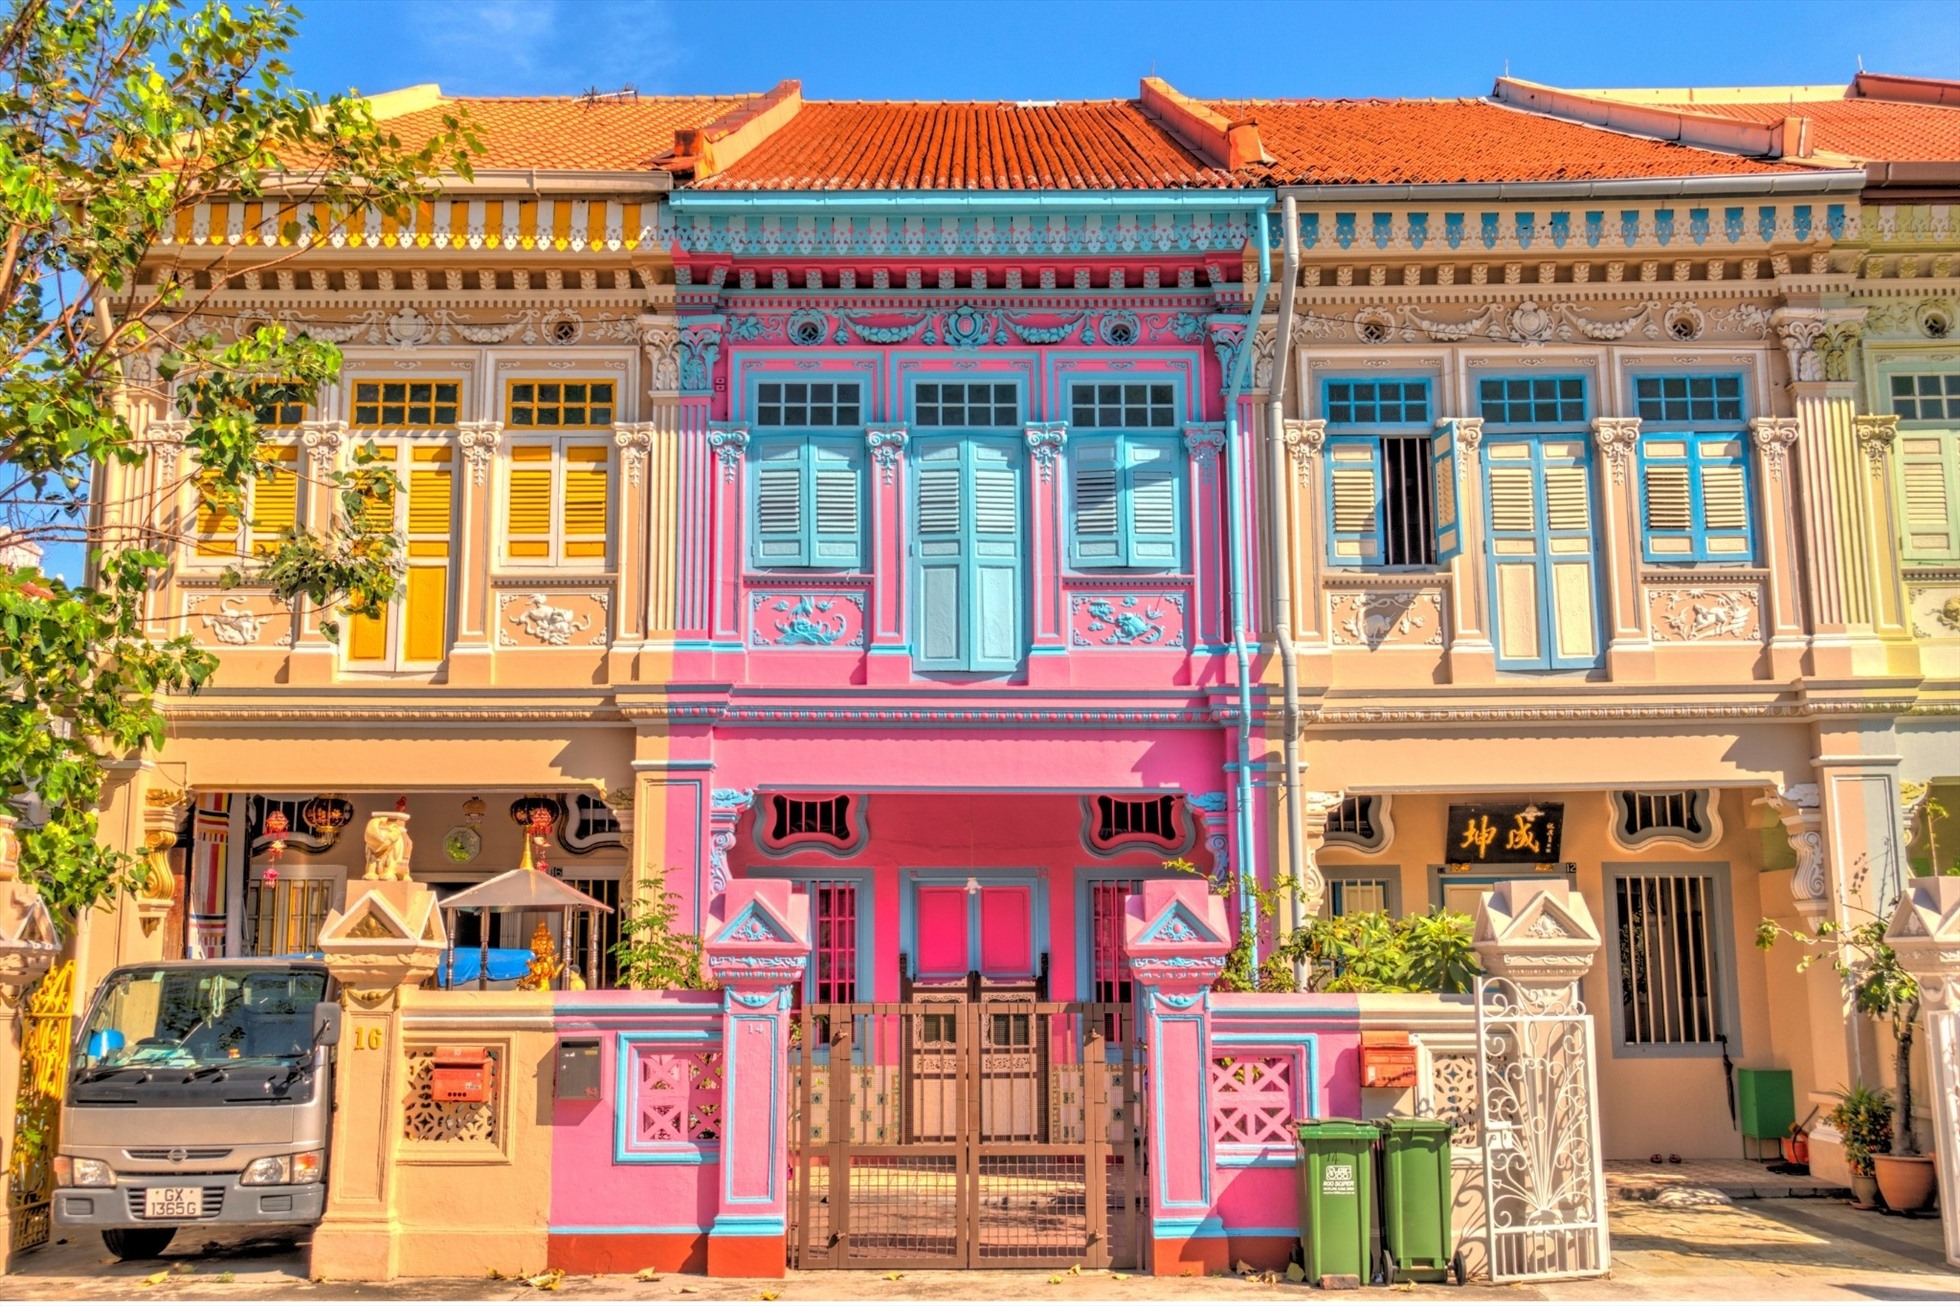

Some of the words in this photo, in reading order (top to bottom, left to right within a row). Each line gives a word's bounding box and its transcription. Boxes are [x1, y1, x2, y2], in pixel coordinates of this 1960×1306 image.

[1566, 862, 1577, 873] 12
[748, 1023, 764, 1034] 14
[354, 1026, 382, 1051] 16
[165, 1188, 184, 1202] GX
[151, 1202, 197, 1215] 1365G
